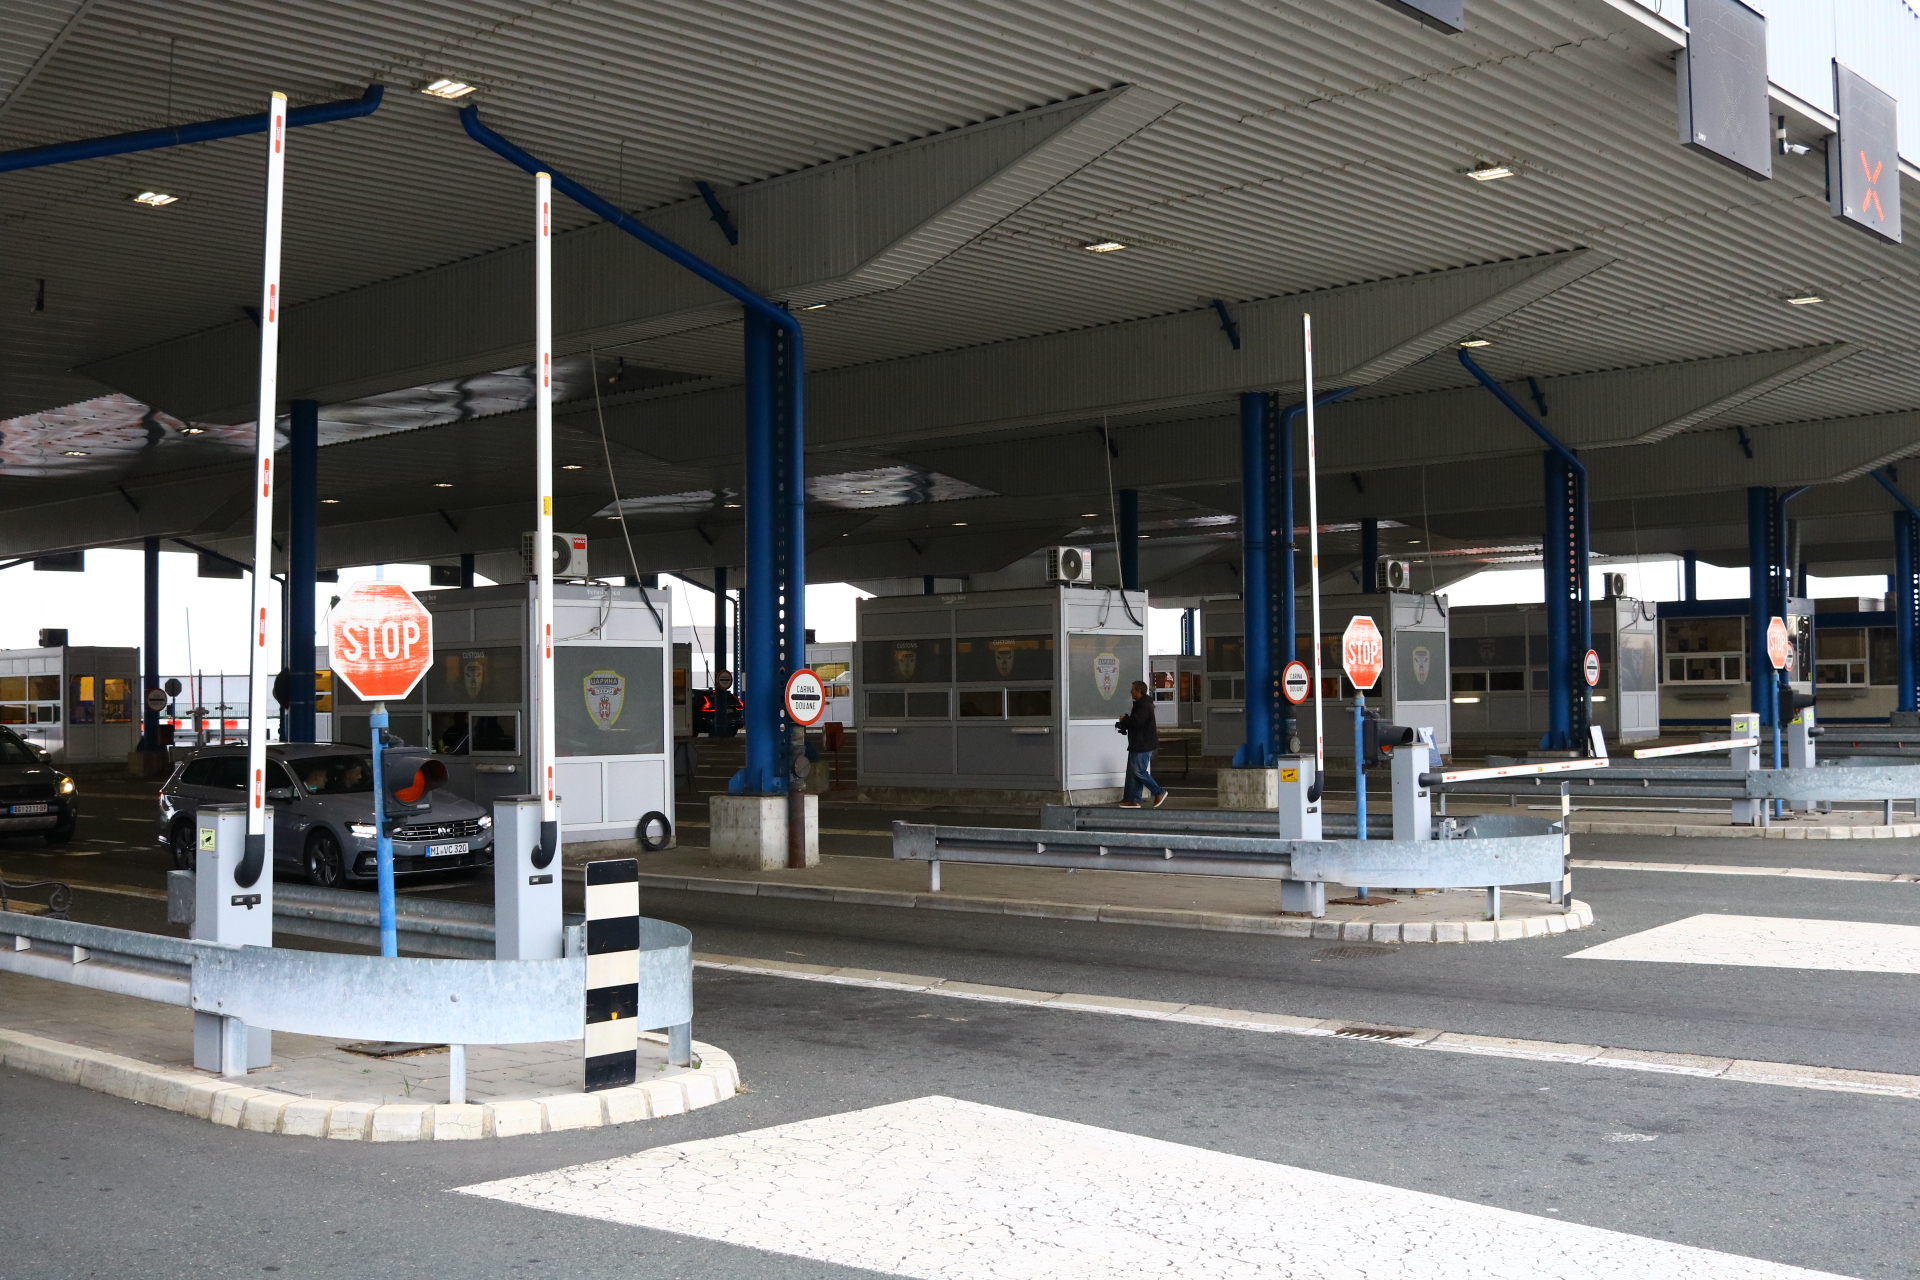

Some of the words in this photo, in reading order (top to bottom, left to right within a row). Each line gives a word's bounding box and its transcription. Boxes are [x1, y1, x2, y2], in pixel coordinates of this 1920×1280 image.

[342, 621, 420, 661] STOP
[1770, 634, 1786, 651] STOP
[1348, 640, 1378, 665] STOP
[796, 685, 815, 693] CARINA
[796, 702, 816, 710] DOUANE
[454, 844, 466, 853] 320
